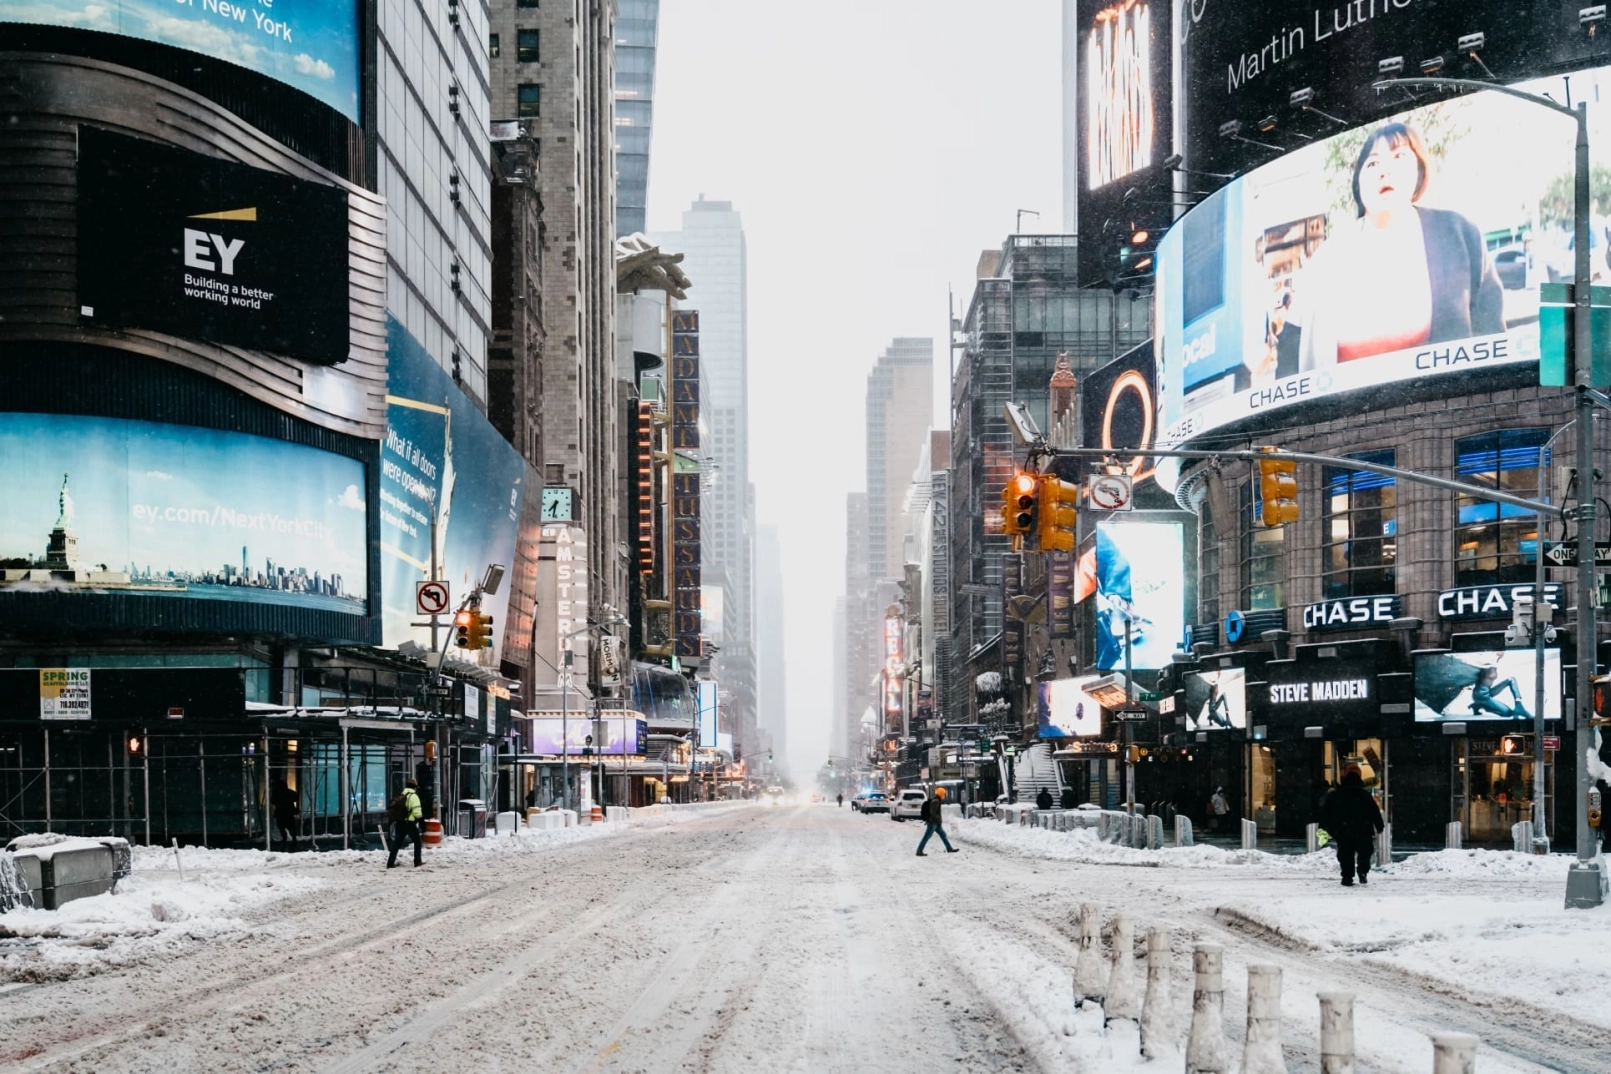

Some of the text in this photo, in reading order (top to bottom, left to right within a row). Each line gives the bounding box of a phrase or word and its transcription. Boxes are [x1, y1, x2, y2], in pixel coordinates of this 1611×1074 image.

[203, 0, 292, 44] New York
[1228, 27, 1304, 94] Martin
[184, 227, 246, 276] EY
[184, 273, 274, 301] Building a better
[184, 287, 261, 310] working world
[1415, 339, 1508, 370] CHASE
[675, 311, 697, 447] MADAME
[1250, 376, 1311, 409] CHASE
[383, 458, 402, 483] were
[412, 448, 421, 468] all
[420, 453, 436, 480] doors
[132, 504, 334, 541] ey.com/NextYorkCity
[677, 474, 697, 657] TUSSAUDS
[932, 545, 948, 595] STUDIOS
[1303, 597, 1394, 628] CHASE
[1438, 586, 1559, 616] CHASE
[43, 671, 88, 681] SPRING
[886, 618, 902, 711] REGAL
[1270, 679, 1368, 704] STEVE MADDEN
